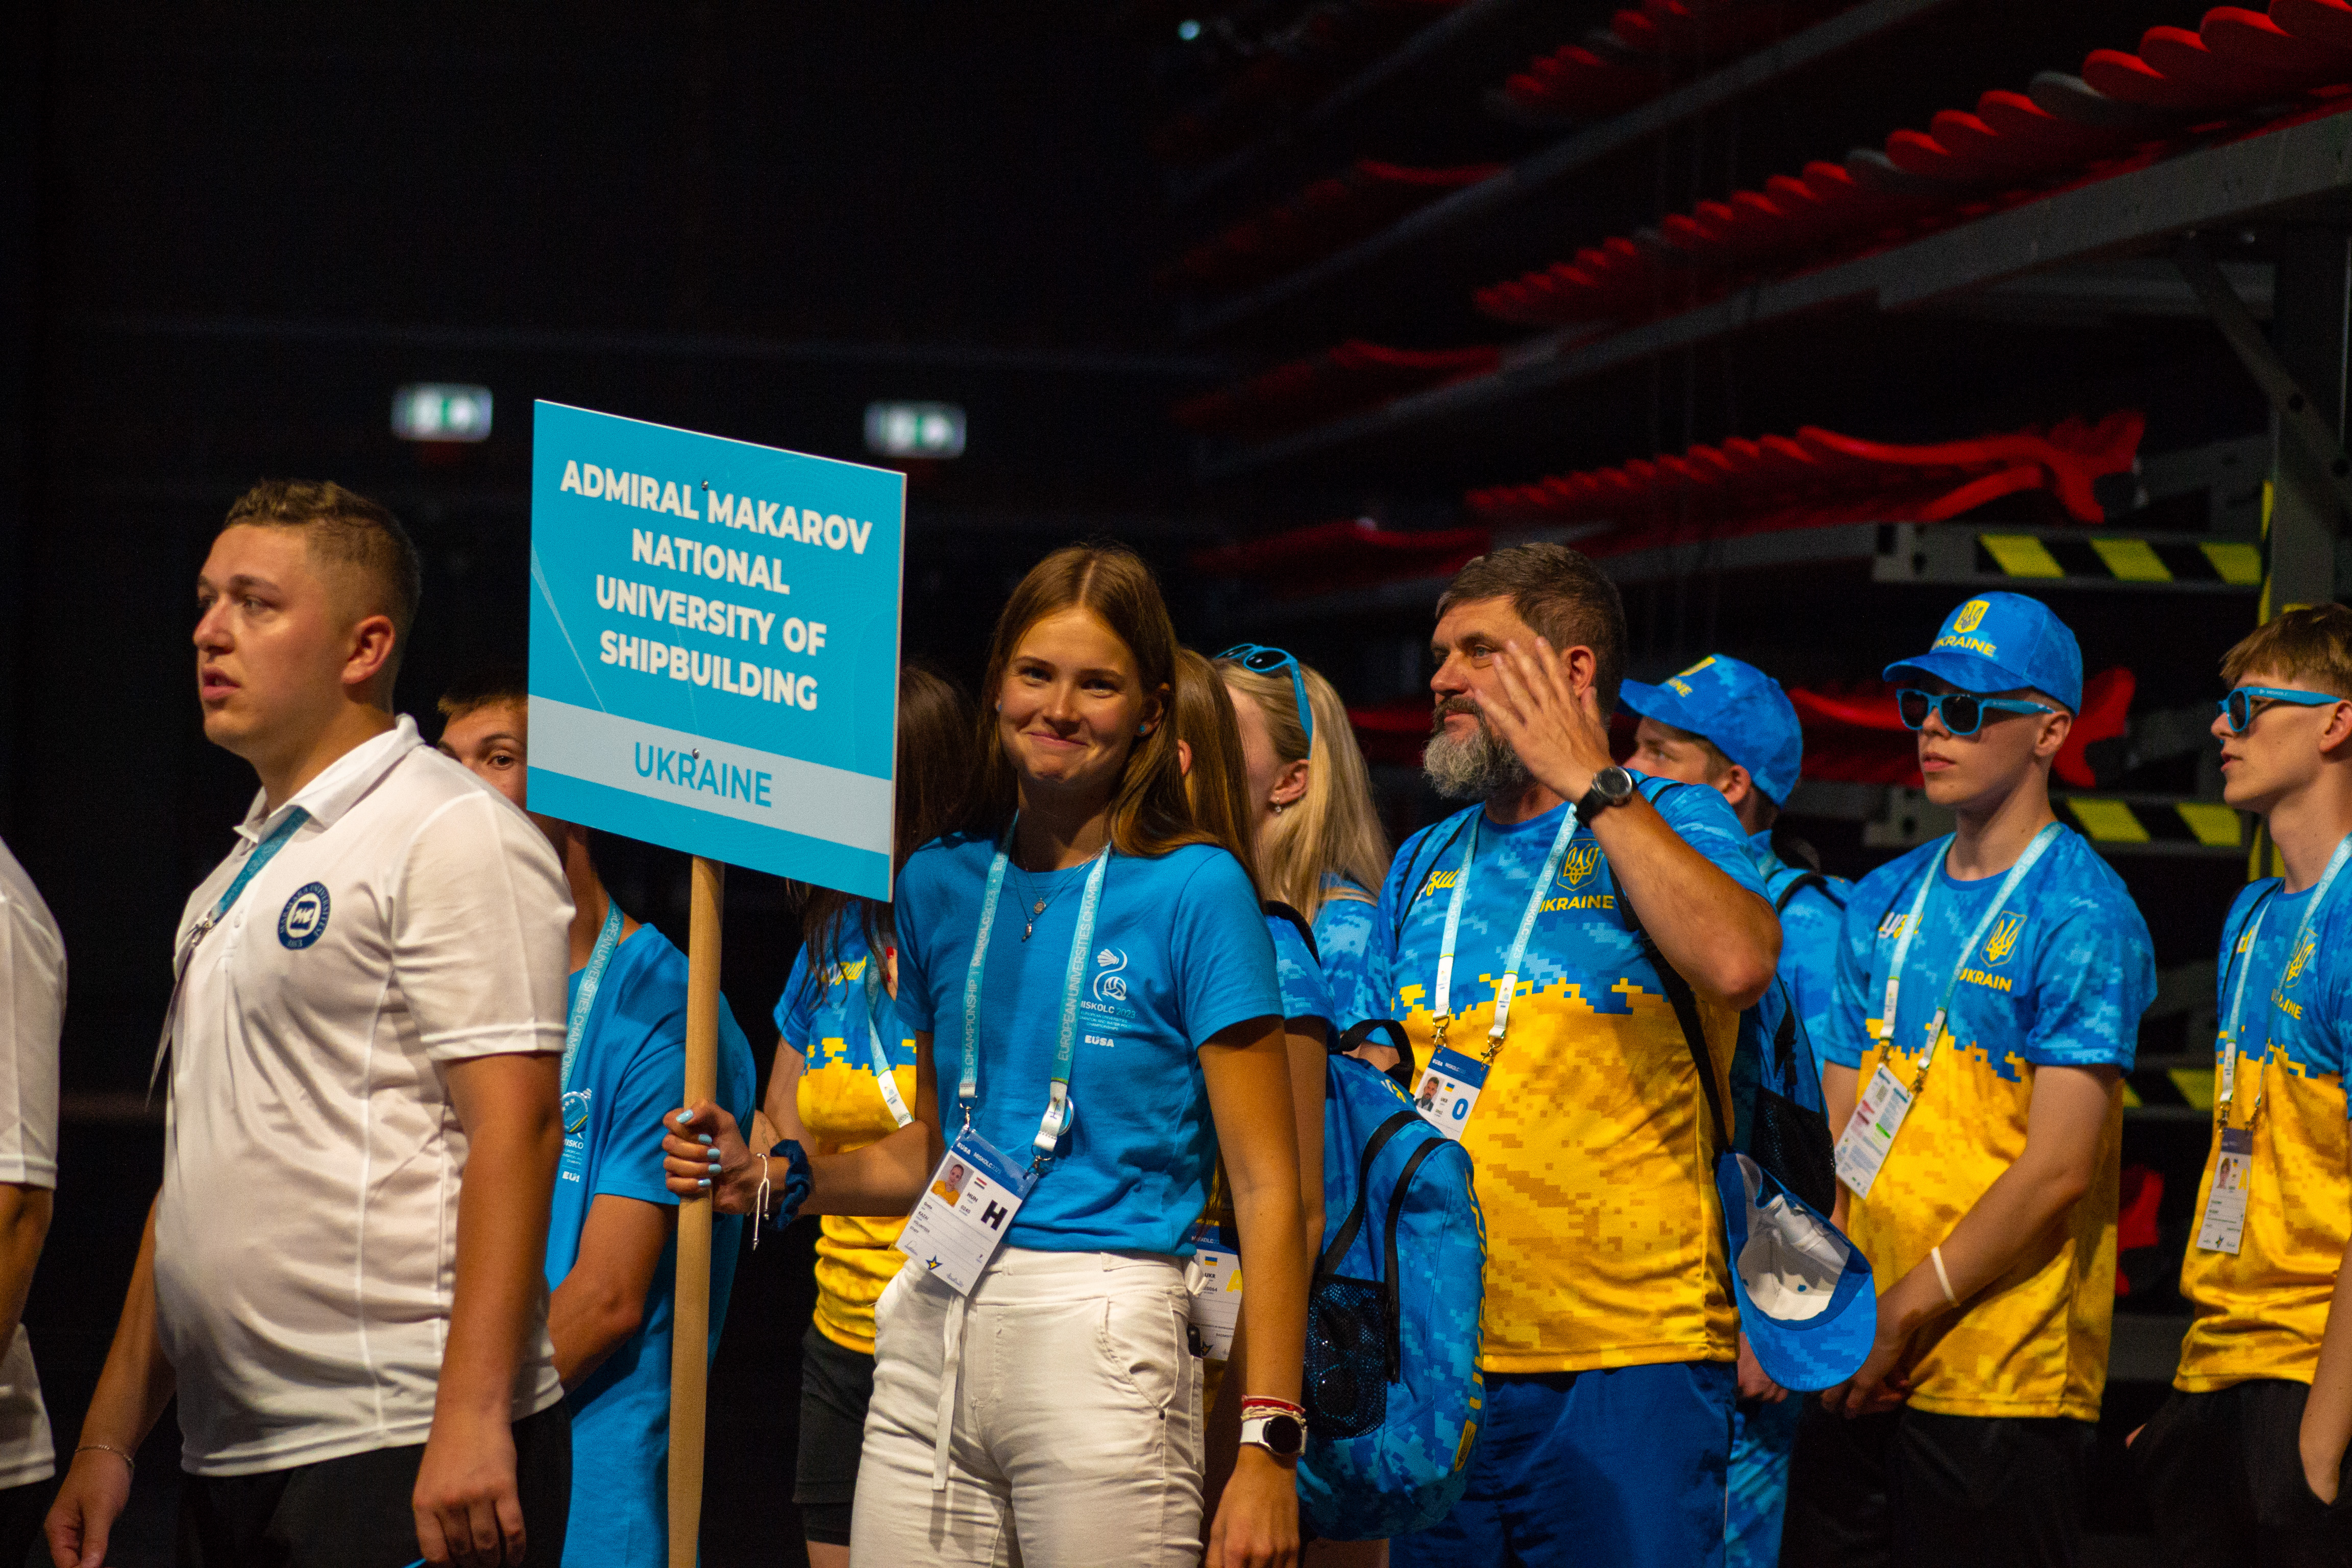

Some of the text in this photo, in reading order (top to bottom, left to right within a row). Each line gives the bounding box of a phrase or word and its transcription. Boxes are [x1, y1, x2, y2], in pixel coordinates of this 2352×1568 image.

[560, 459, 873, 554] ADMIRAL MAKAROV
[632, 528, 790, 594] NATIONAL
[596, 575, 826, 656] UNIVERSITY OF
[600, 630, 818, 710] SHIPBUILDING
[635, 742, 773, 807] UKRAINE
[1445, 889, 1465, 939] EUROPEAN
[577, 949, 607, 1014] UNIVERSITIES
[1058, 999, 1078, 1061] EUROPEAN
[1069, 924, 1091, 997] UNIVERSITIES
[1116, 1007, 1136, 1019] 2023
[964, 979, 976, 1064] CHAMPIONSHIP
[1085, 1035, 1114, 1047] EUSA
[957, 1142, 971, 1155] EUSA
[967, 1192, 978, 1203] HUN
[981, 1199, 1008, 1231] H
